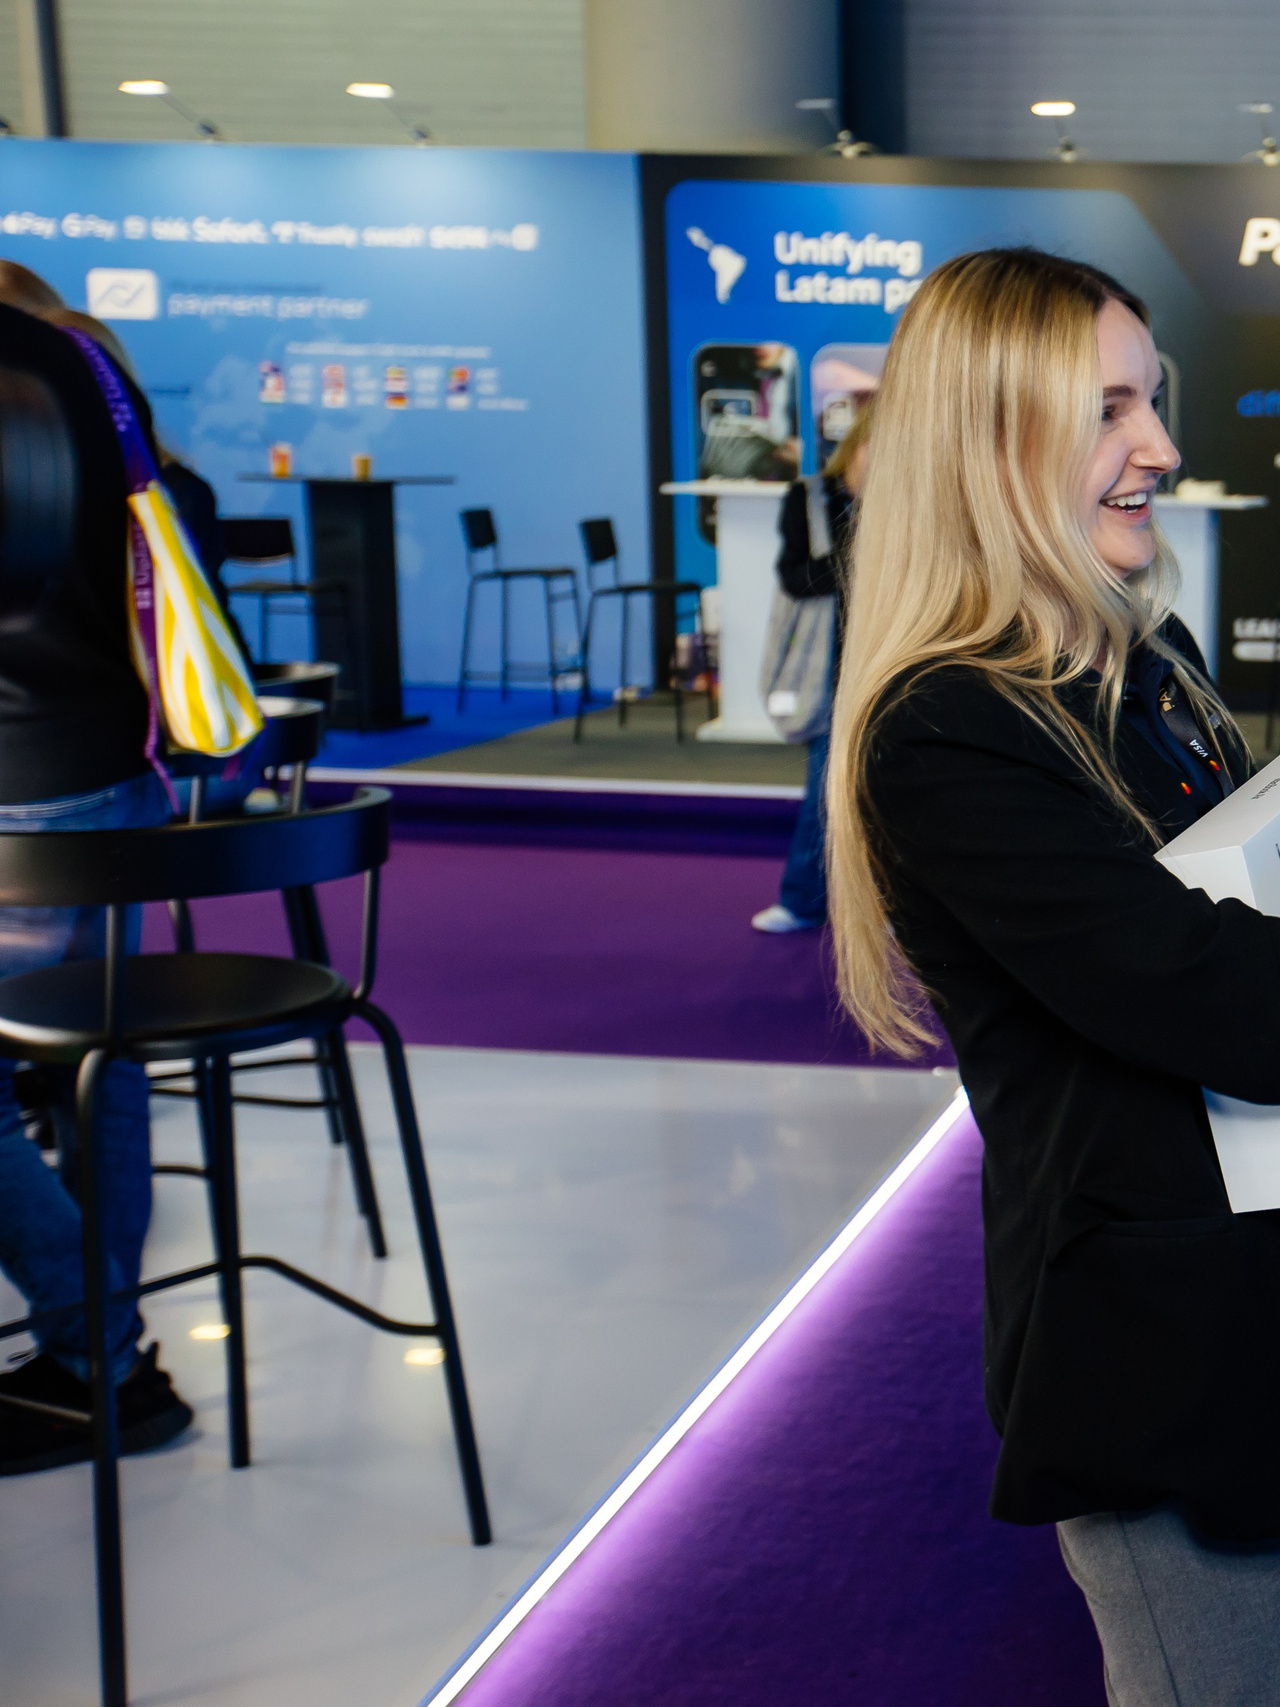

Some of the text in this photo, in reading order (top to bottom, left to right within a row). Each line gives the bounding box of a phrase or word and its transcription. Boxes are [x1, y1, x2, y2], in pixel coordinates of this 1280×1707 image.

[774, 231, 922, 276] Unifying
[775, 269, 882, 304] Latam
[167, 294, 370, 321] payment partner
[1189, 738, 1209, 758] VISA
